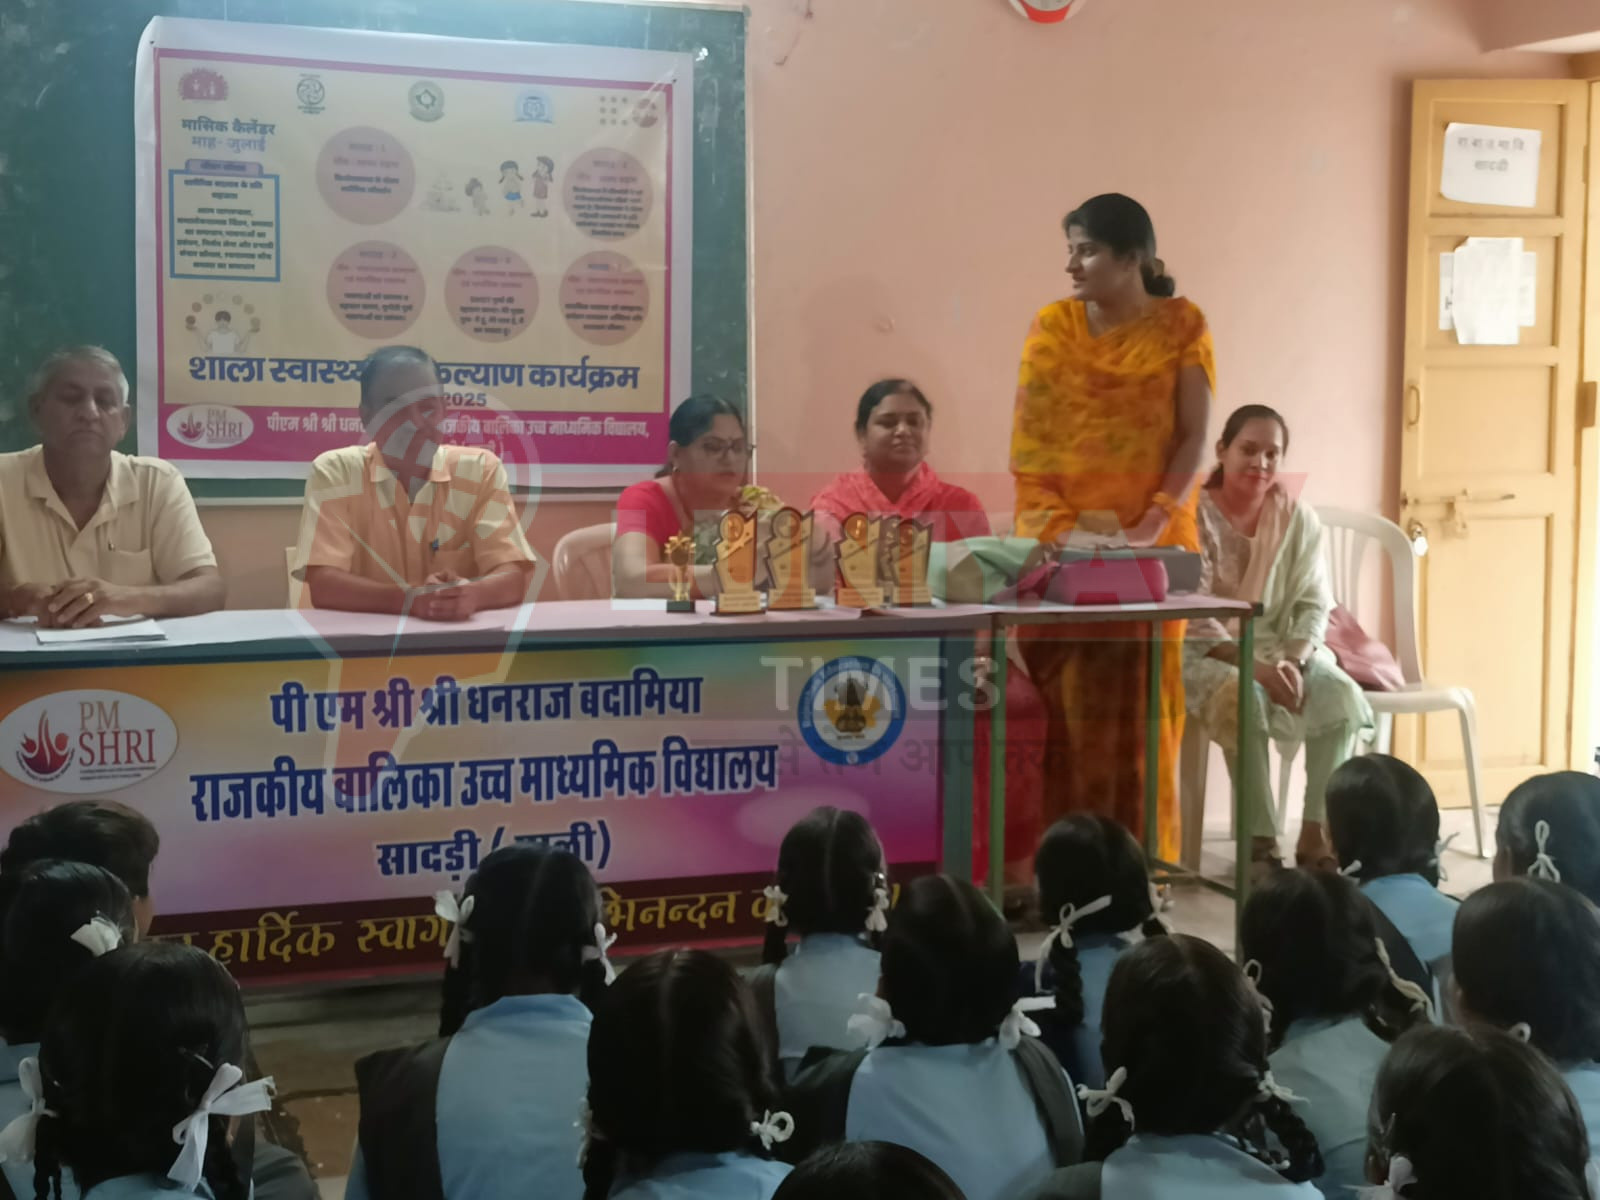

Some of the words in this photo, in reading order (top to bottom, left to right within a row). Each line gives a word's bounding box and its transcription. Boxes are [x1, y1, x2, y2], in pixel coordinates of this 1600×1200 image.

[181, 115, 229, 133] मासिक
[226, 136, 267, 154] जुलाई
[189, 356, 266, 383] शाला
[527, 355, 641, 395] कार्यक्रम
[206, 421, 244, 439] SHRI
[79, 701, 120, 731] PM
[270, 681, 309, 733] पी
[314, 690, 367, 731] एम
[371, 677, 415, 728] श्री
[420, 675, 461, 726] श्री
[466, 682, 574, 724] धनराज
[579, 667, 704, 718] बदामिया
[79, 728, 156, 767] SHRI
[189, 755, 328, 822] राजकीय
[332, 750, 455, 813] बालिका
[458, 758, 515, 806] उच्च
[519, 738, 657, 802] माध्यमिक
[662, 735, 779, 794] विद्यालय
[376, 829, 482, 881] सादड़ी
[208, 911, 343, 964] हार्दिक
[356, 914, 449, 953] स्वाग
[599, 886, 743, 931] भिनन्दन
